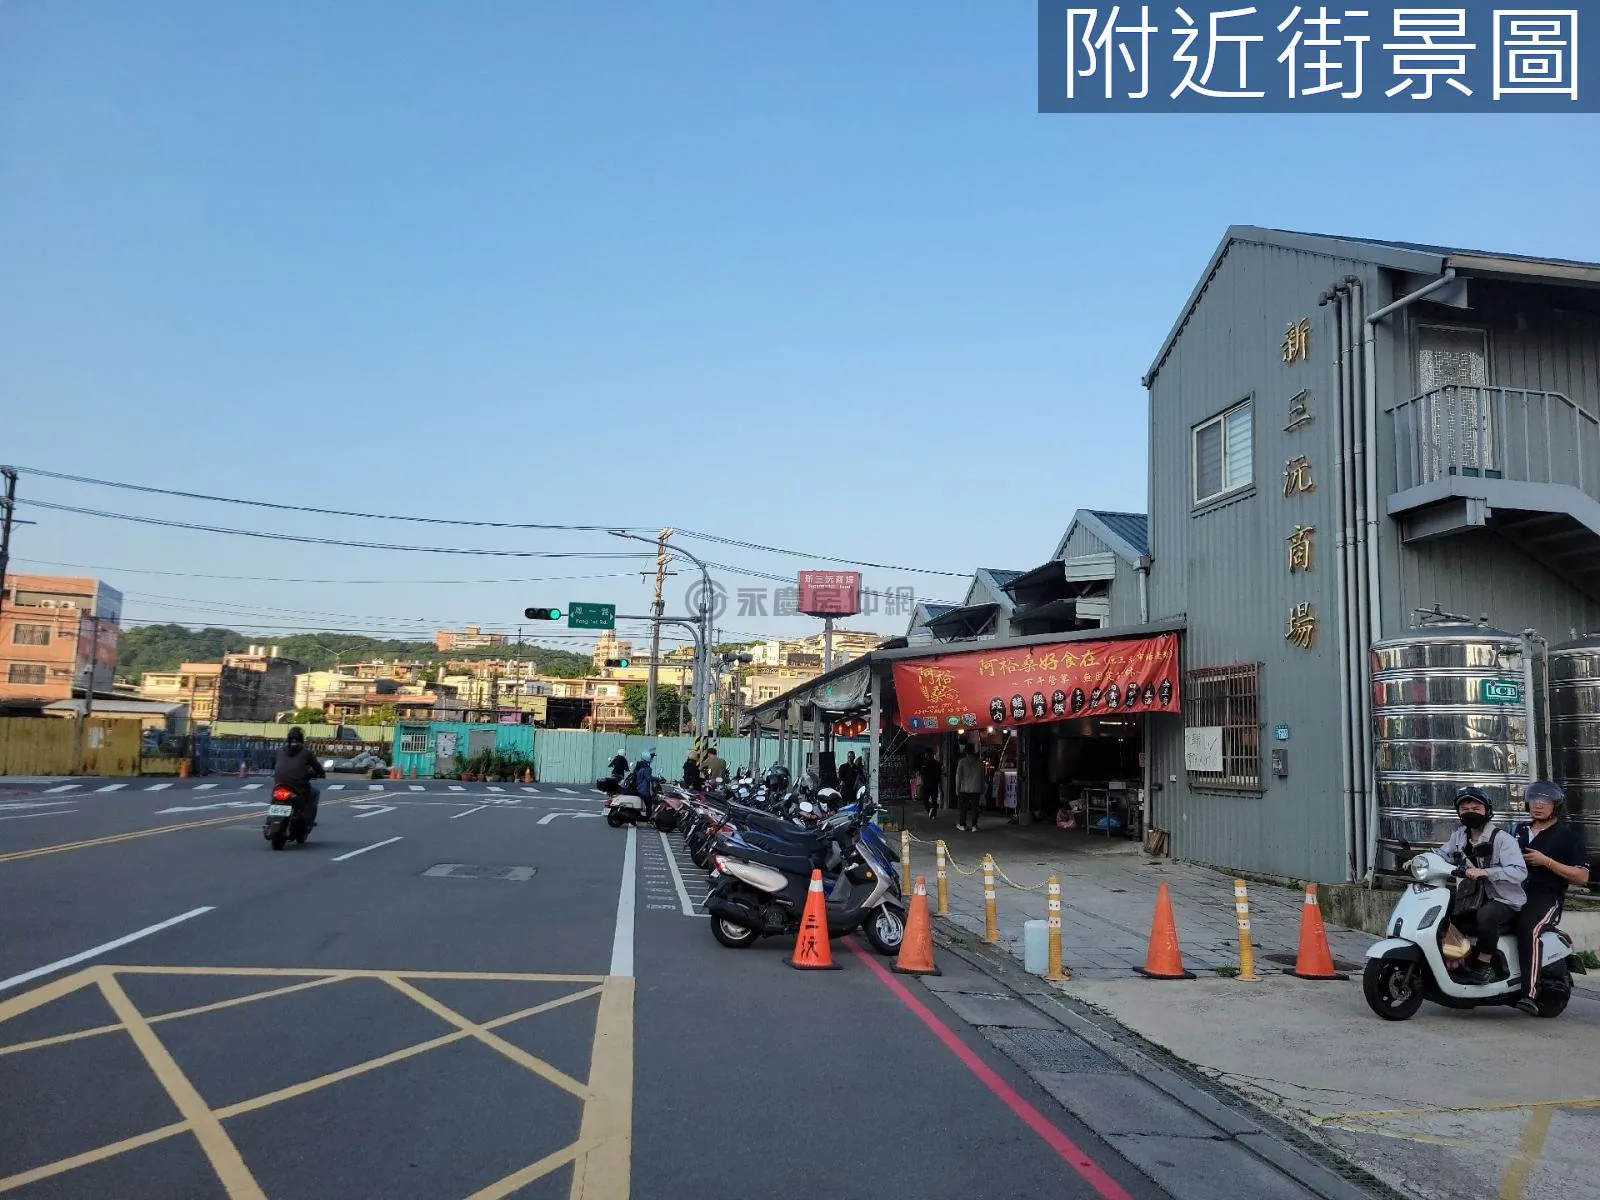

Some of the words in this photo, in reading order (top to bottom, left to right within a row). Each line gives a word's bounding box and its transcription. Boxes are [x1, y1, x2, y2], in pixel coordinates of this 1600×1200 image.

[1282, 318, 1316, 651] 新三沅商場
